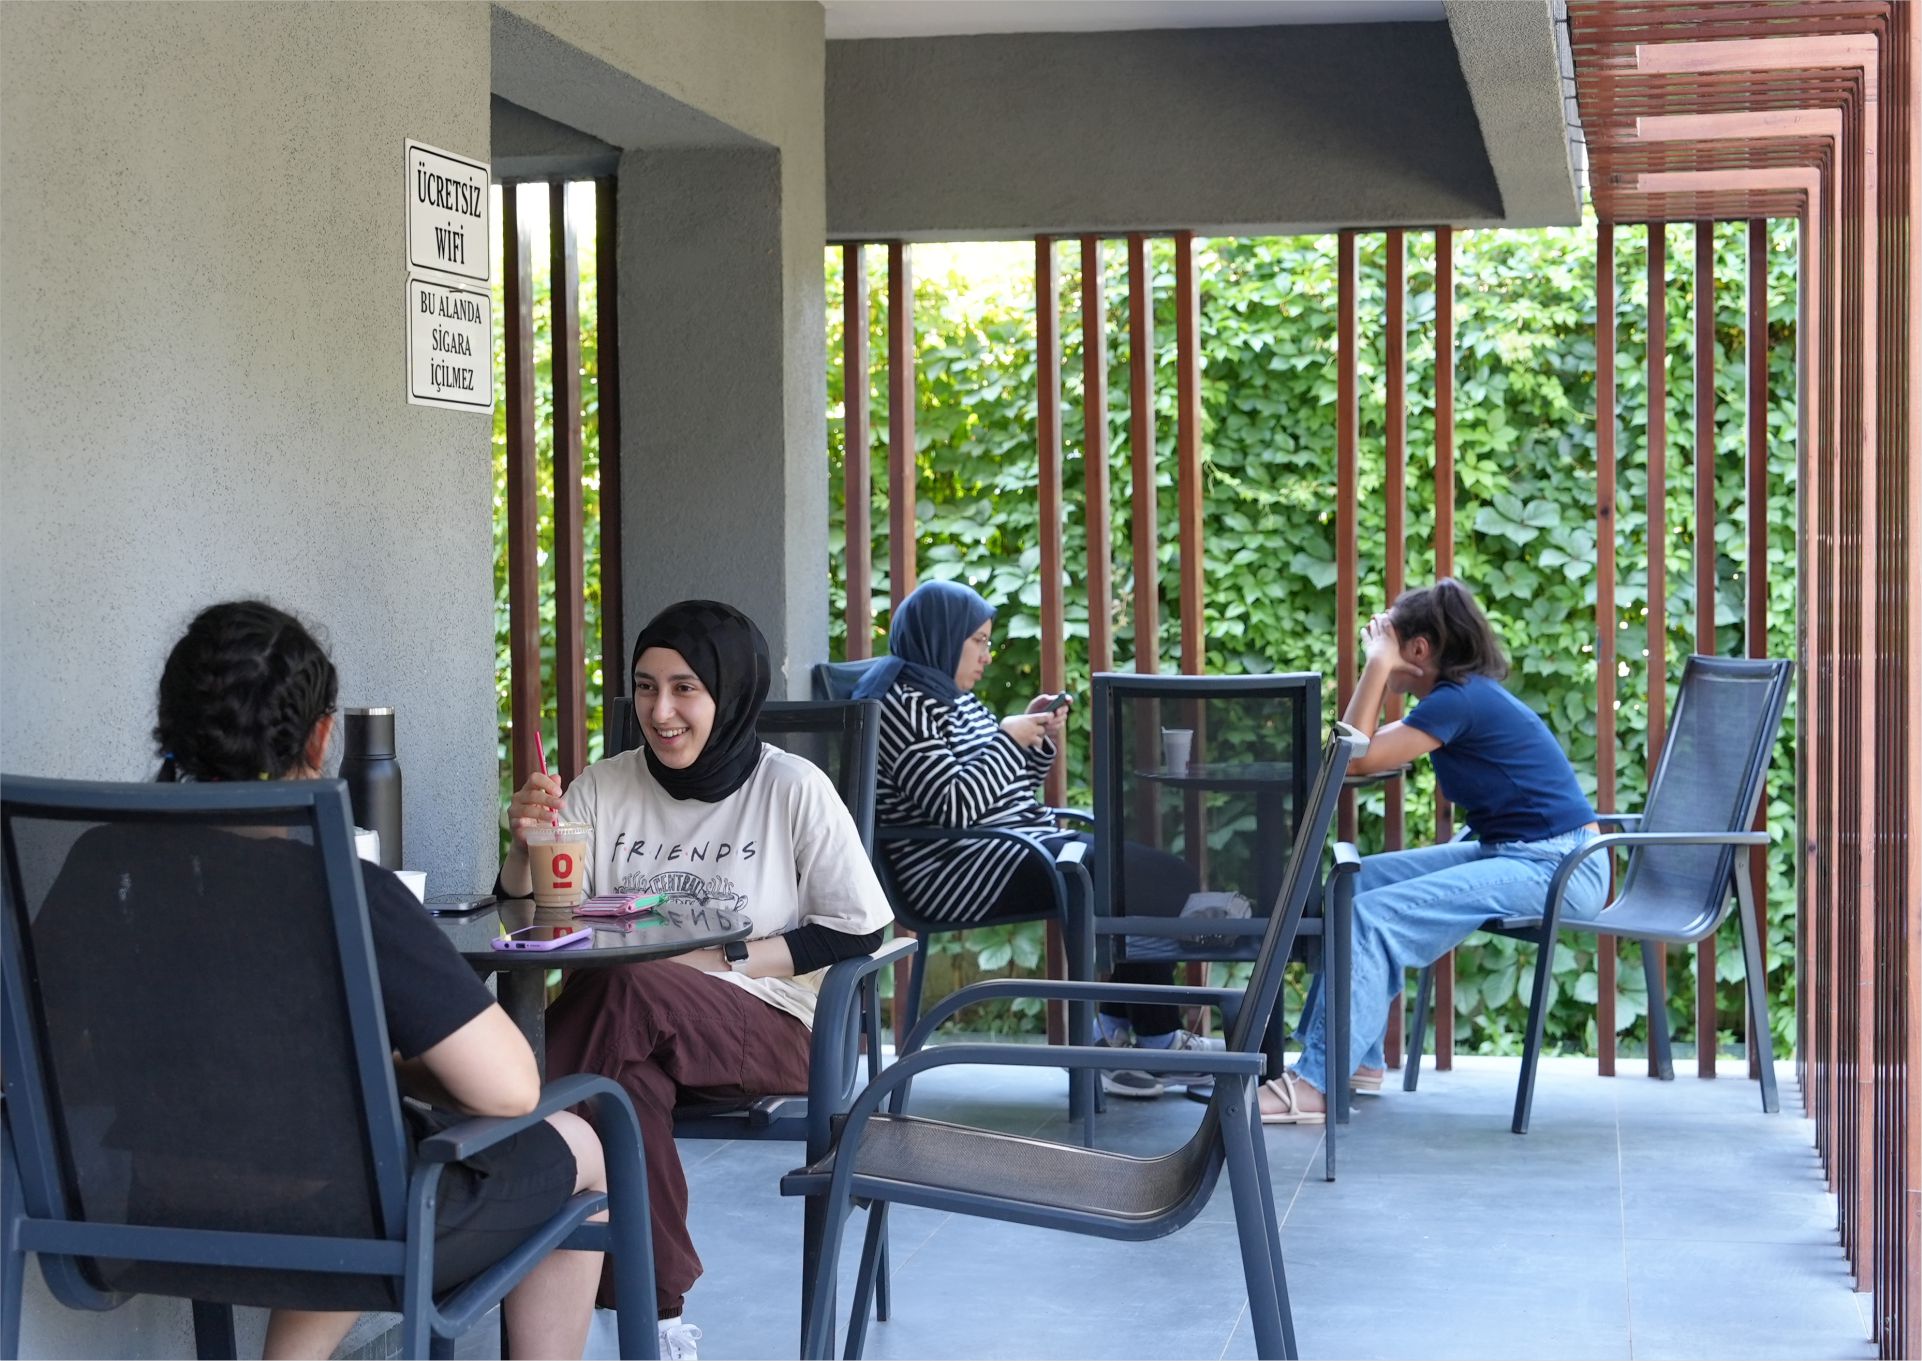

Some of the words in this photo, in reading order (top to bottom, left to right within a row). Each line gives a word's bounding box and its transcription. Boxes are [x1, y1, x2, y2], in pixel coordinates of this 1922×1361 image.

[417, 161, 481, 219] ÜCRETSİZ
[434, 221, 465, 265] WİFİ
[420, 290, 436, 315] BU
[438, 295, 482, 325] ALANDA
[432, 323, 472, 357] SİGARA
[430, 357, 474, 393] İÇİLMEZ
